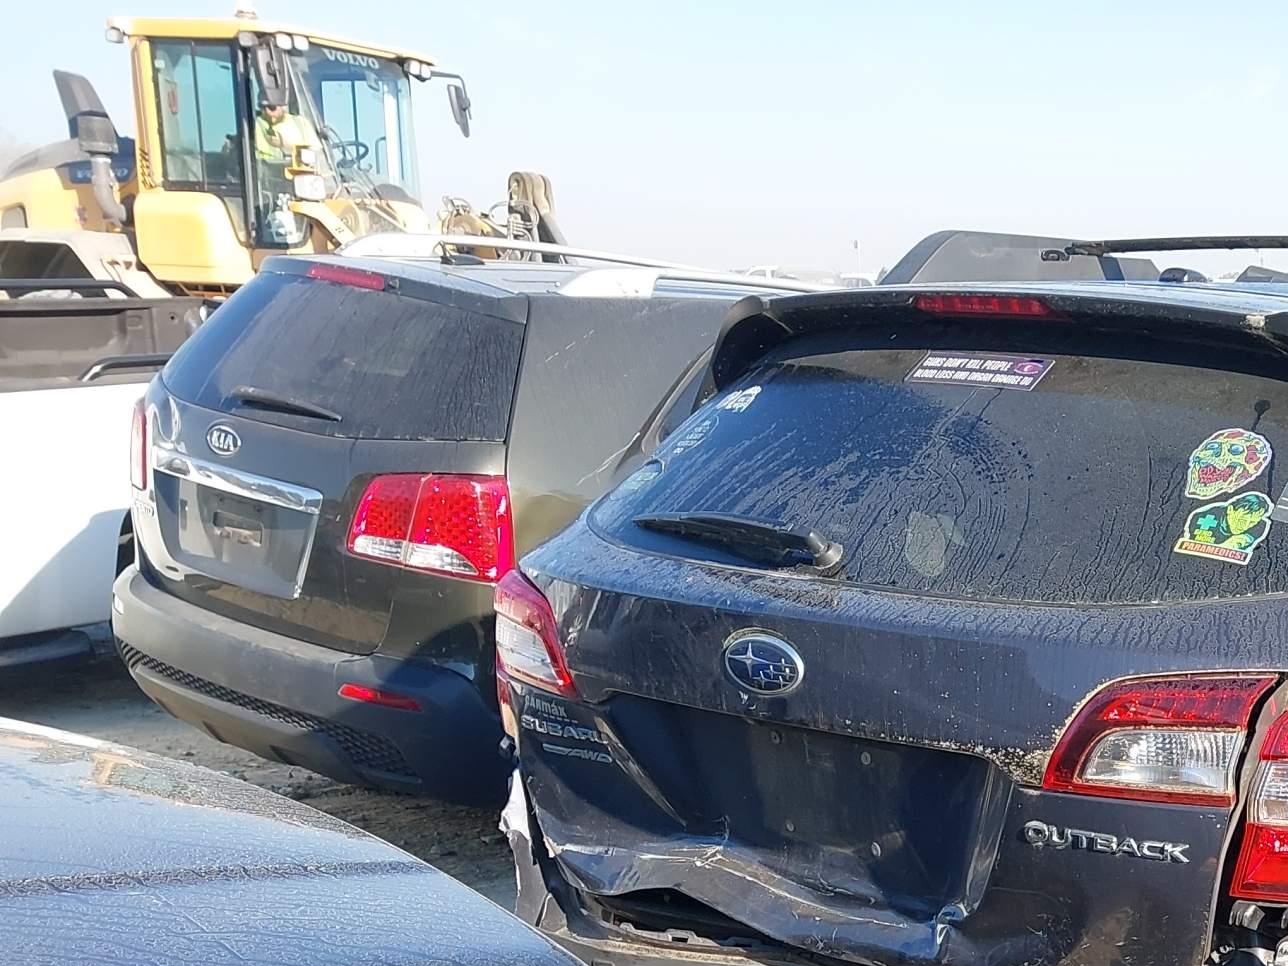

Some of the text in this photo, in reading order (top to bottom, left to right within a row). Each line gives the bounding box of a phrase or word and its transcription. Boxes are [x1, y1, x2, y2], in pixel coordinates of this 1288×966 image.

[321, 47, 380, 70] VOLVO
[934, 369, 955, 379] LOSS
[965, 358, 984, 369] KILL
[982, 359, 1014, 371] PEOPLE
[211, 430, 234, 451] KIA
[1181, 541, 1247, 561] PARAMEDICS!
[520, 714, 608, 744] SUBARU
[568, 748, 613, 763] AWD
[1023, 820, 1190, 863] OUTBACK
